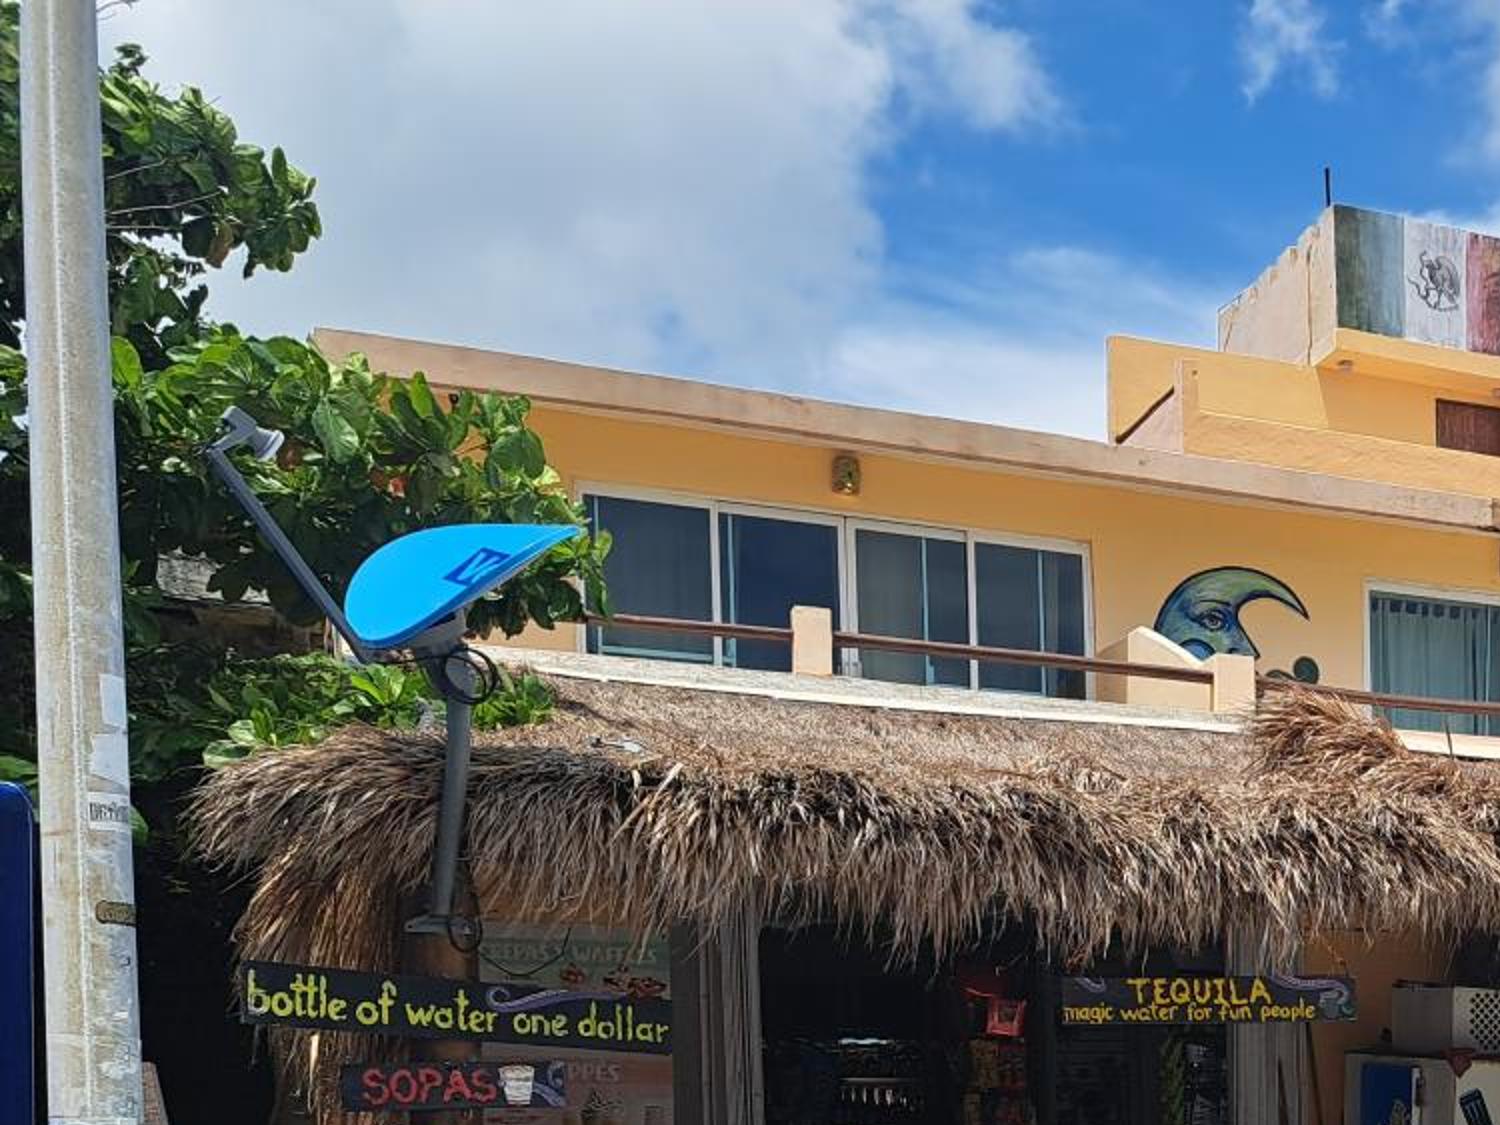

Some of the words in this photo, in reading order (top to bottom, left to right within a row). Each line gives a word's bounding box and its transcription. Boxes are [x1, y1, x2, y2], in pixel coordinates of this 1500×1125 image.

[247, 968, 347, 1021] bottle
[355, 979, 397, 1025] of
[405, 989, 498, 1034] water
[513, 1012, 569, 1038] one
[577, 999, 670, 1044] dollar
[1127, 977, 1274, 1006] TEQUILA
[1063, 1003, 1113, 1024] magic
[1120, 1004, 1178, 1022] water
[1187, 1003, 1213, 1022] for
[1218, 1005, 1252, 1022] fun
[1260, 998, 1316, 1022] people
[361, 1067, 497, 1106] SOPAS
